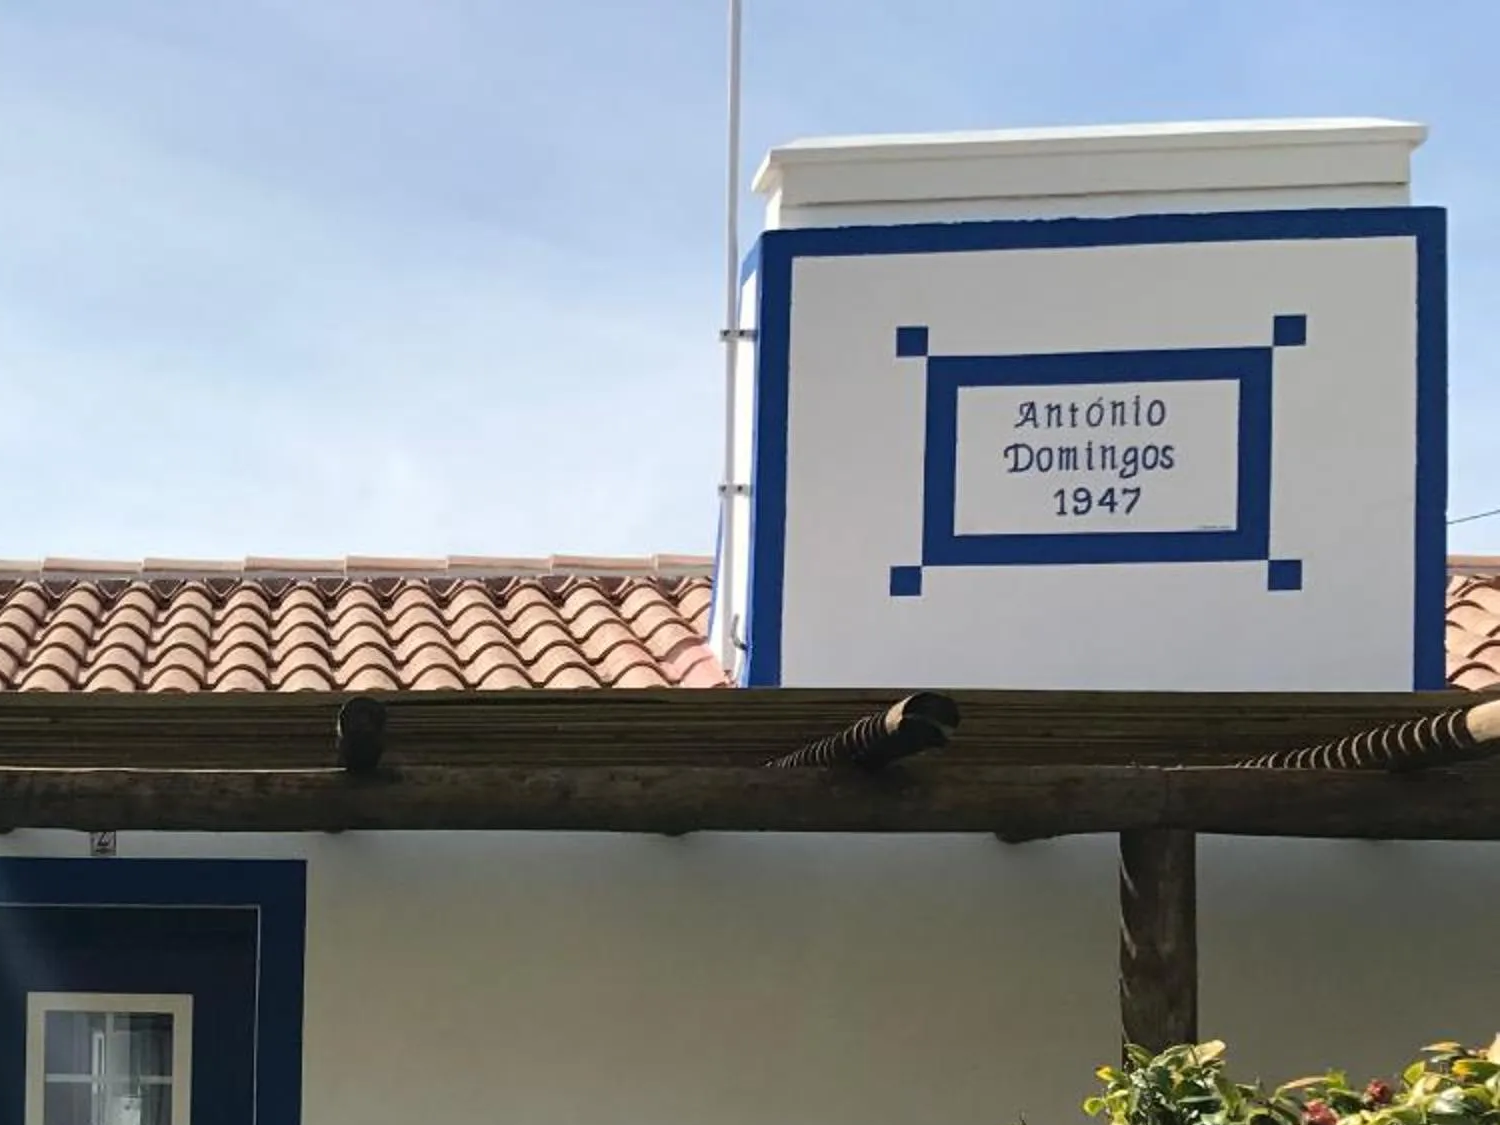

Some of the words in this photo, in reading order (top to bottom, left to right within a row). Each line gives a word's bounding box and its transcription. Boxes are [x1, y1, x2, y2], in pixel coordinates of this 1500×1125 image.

[1014, 395, 1167, 429] António
[1003, 440, 1176, 479] Domingos
[1053, 487, 1142, 516] 1947
